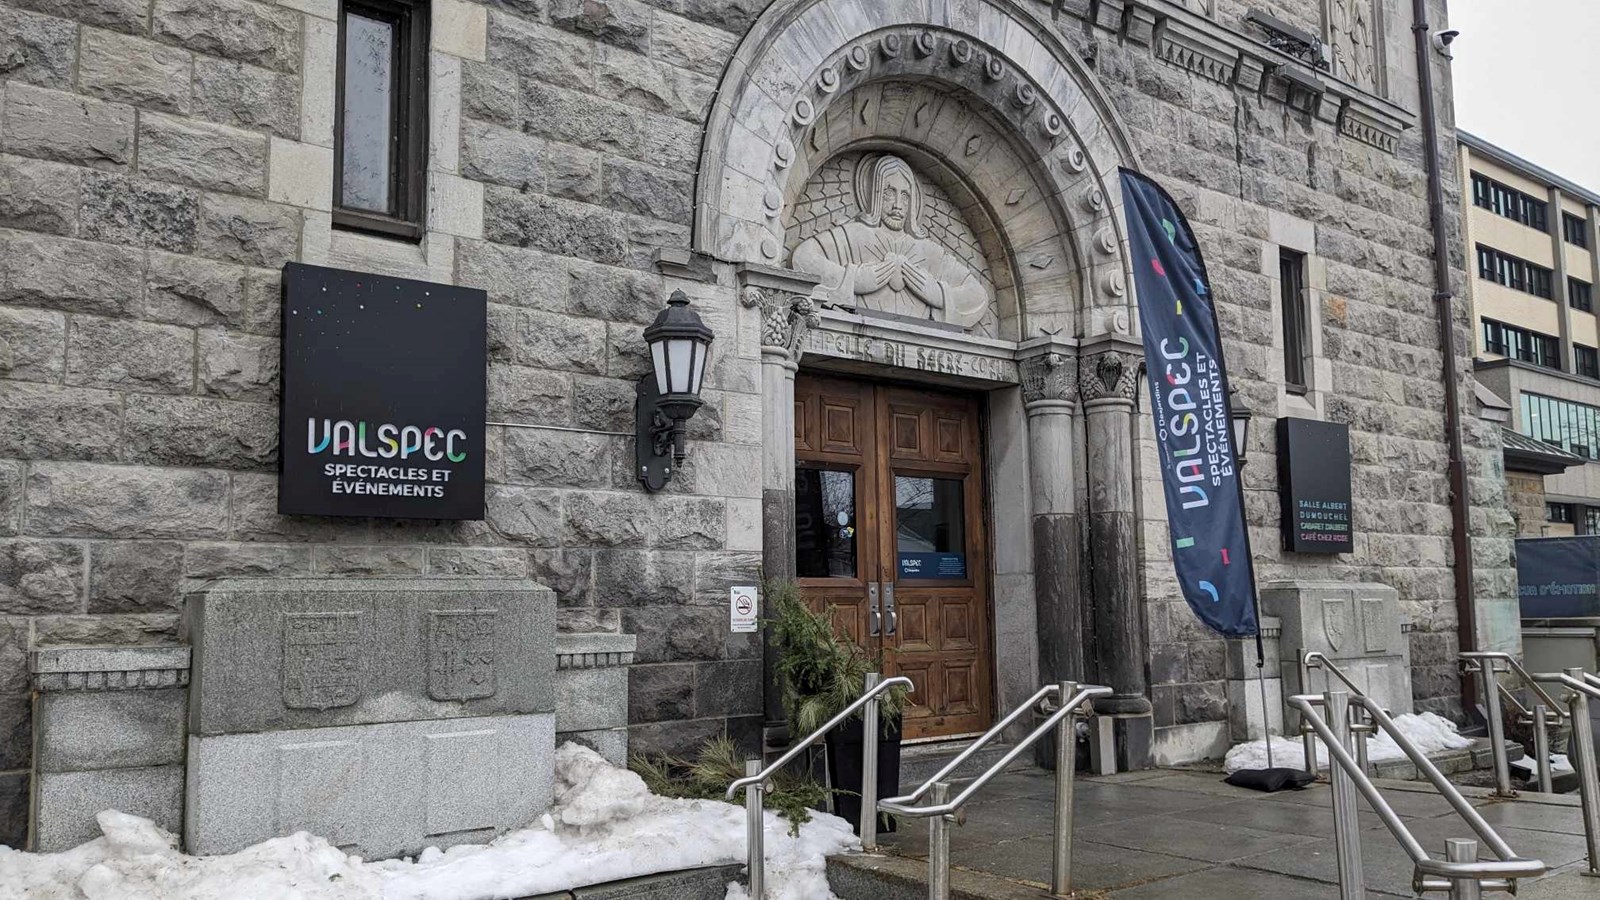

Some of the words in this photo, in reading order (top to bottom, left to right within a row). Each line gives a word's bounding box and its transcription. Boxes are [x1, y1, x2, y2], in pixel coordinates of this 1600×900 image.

[1196, 352, 1206, 374] ET
[1160, 336, 1209, 510] VALSPEC
[1209, 359, 1233, 477] ÉVÉNEMENTS
[307, 417, 467, 463] VALSPEC
[1198, 378, 1221, 487] SPECTACLES
[324, 463, 428, 481] SPECTACLES
[431, 469, 452, 482] ET
[332, 478, 445, 498] ÉVÉNEMENTS
[1299, 500, 1320, 509] SALLE
[1322, 501, 1347, 510] ALBERT
[1299, 511, 1348, 520] DUMOUCHEL
[1300, 531, 1317, 541] CAFÉ
